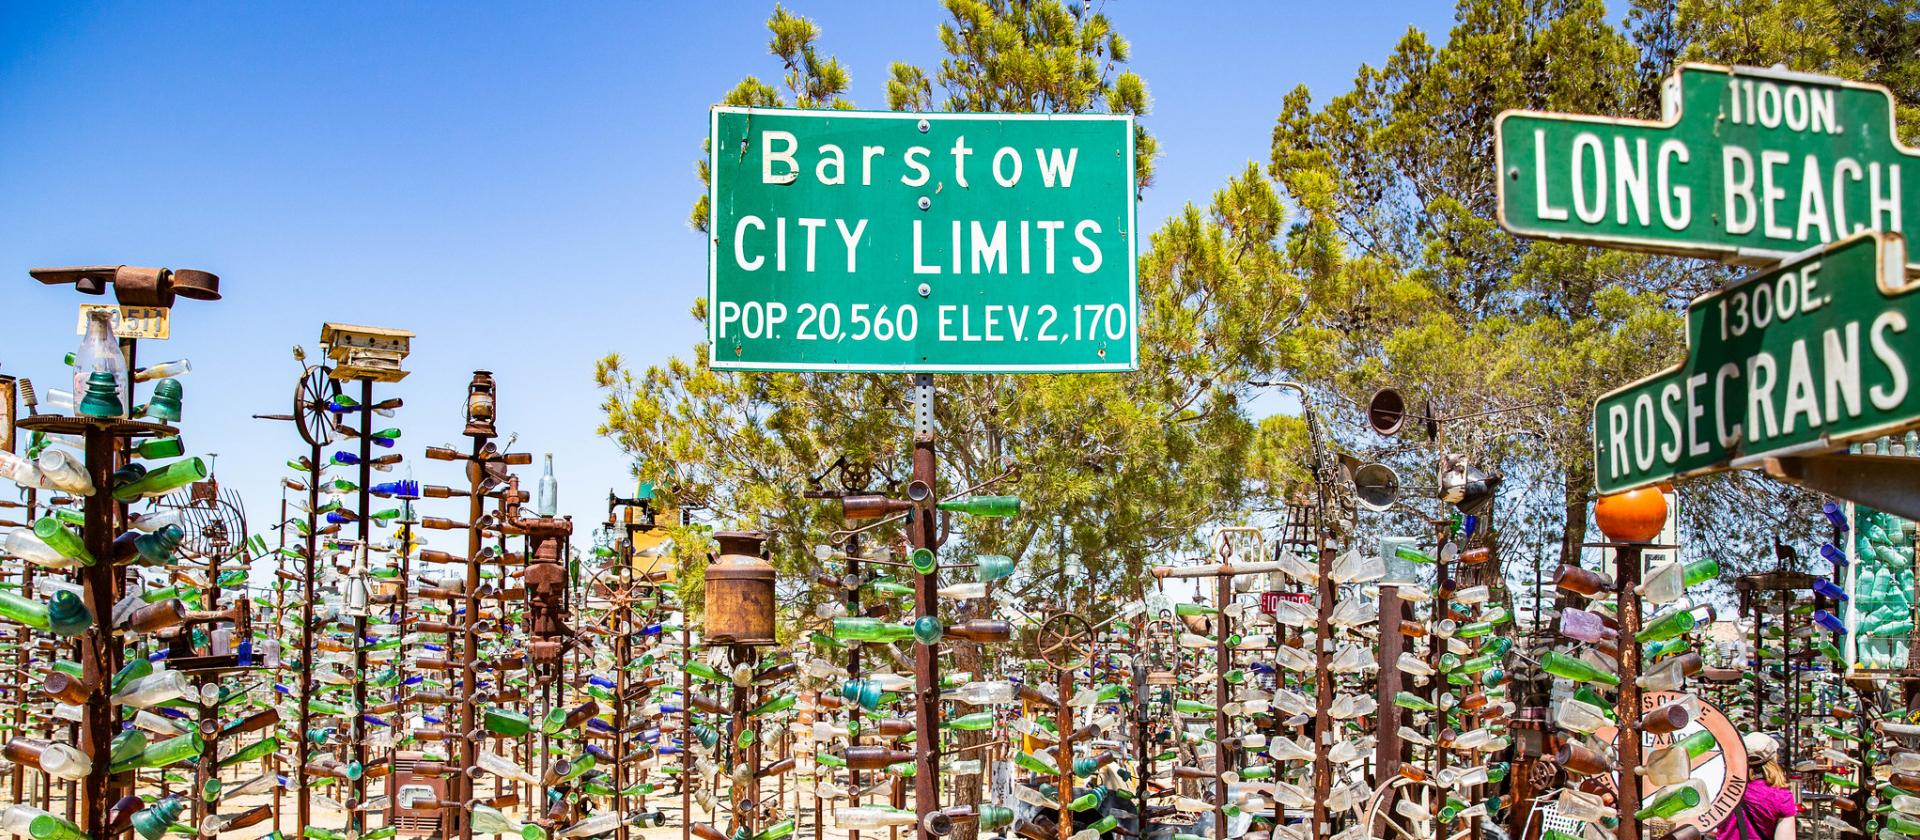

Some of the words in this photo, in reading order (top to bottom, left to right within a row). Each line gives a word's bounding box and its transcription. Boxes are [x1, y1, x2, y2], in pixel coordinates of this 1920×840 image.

[761, 130, 1079, 188] Barstow
[1534, 129, 1691, 231] LONG
[1723, 145, 1902, 243] BEACH
[734, 215, 869, 273] CITY
[913, 219, 1102, 275] LIMITS
[719, 301, 787, 339] POP.
[797, 303, 918, 344] 20,560
[1609, 311, 1909, 479] ROSECRANS
[1698, 775, 1746, 828] STATION
